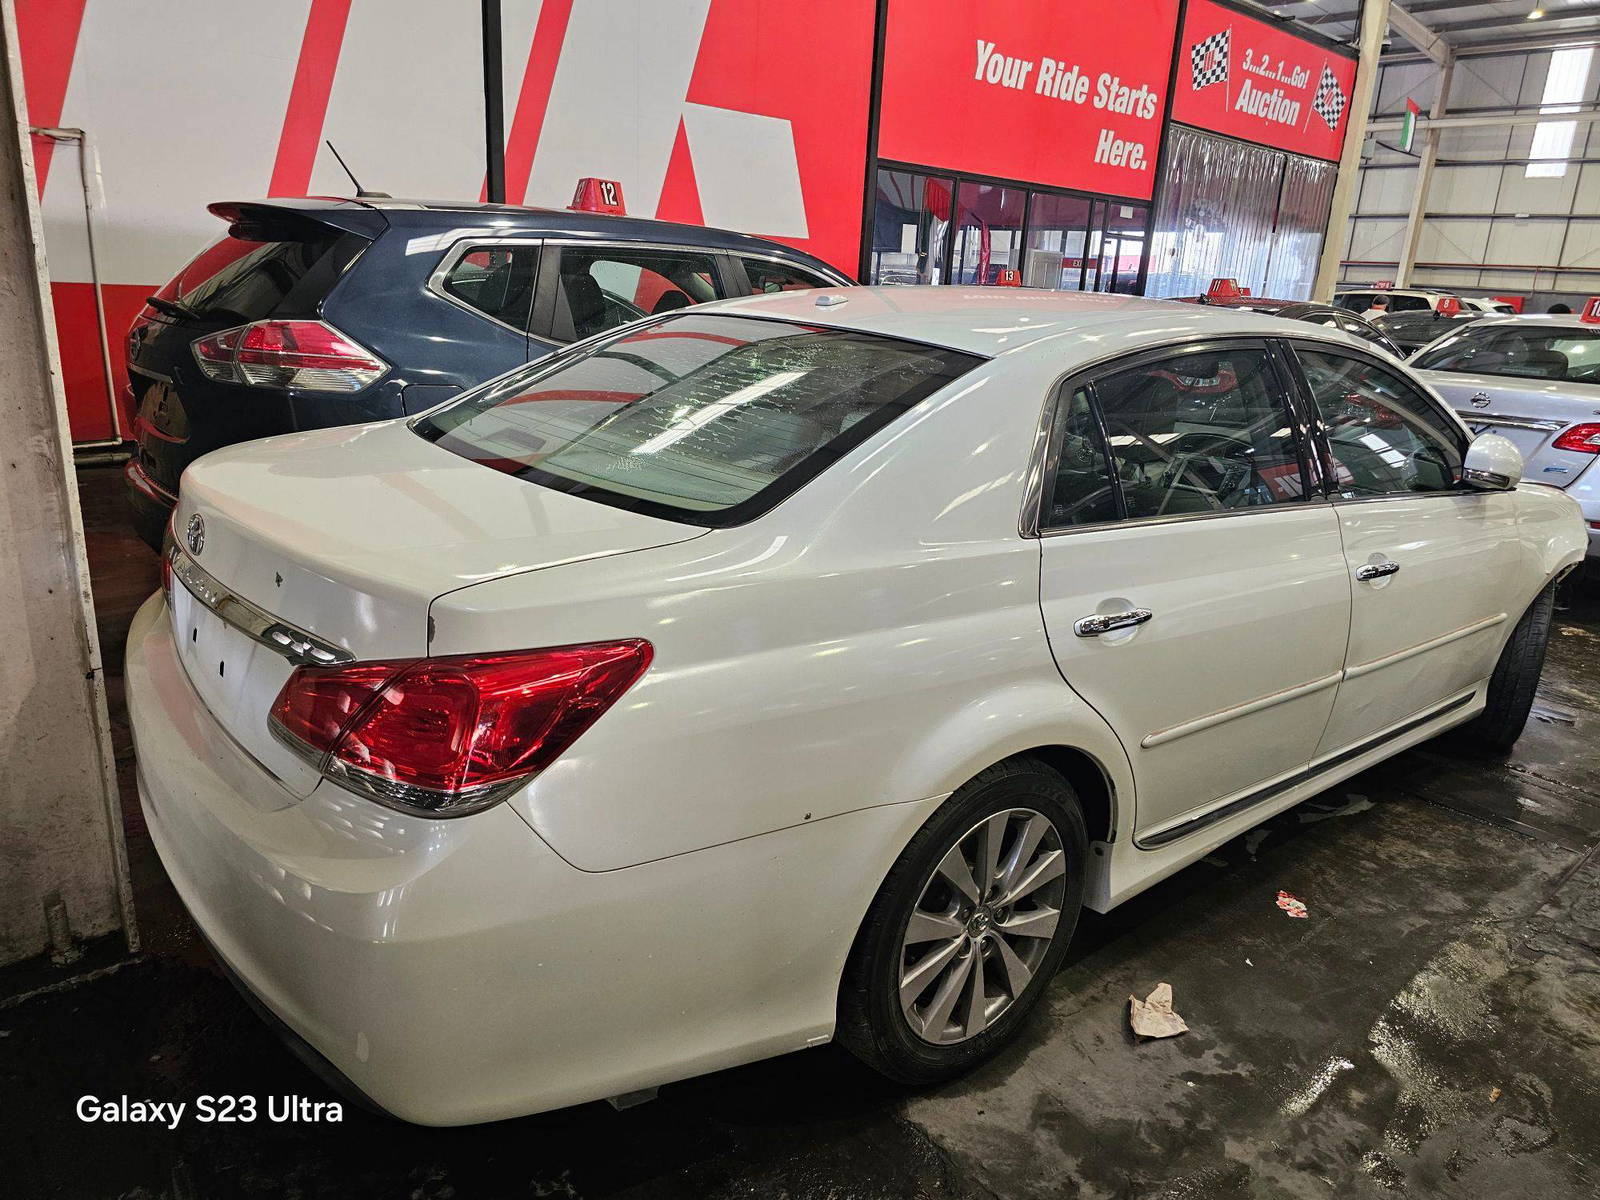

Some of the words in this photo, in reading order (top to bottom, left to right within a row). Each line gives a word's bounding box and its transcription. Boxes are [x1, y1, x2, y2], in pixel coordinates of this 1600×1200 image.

[974, 39, 1034, 90] Your
[1034, 56, 1090, 105] Ride
[1093, 72, 1158, 120] Starts
[1234, 79, 1301, 127] Auction
[1093, 128, 1147, 171] Here.
[600, 182, 618, 206] 12
[1005, 270, 1014, 281] 13
[1443, 299, 1450, 309] 8
